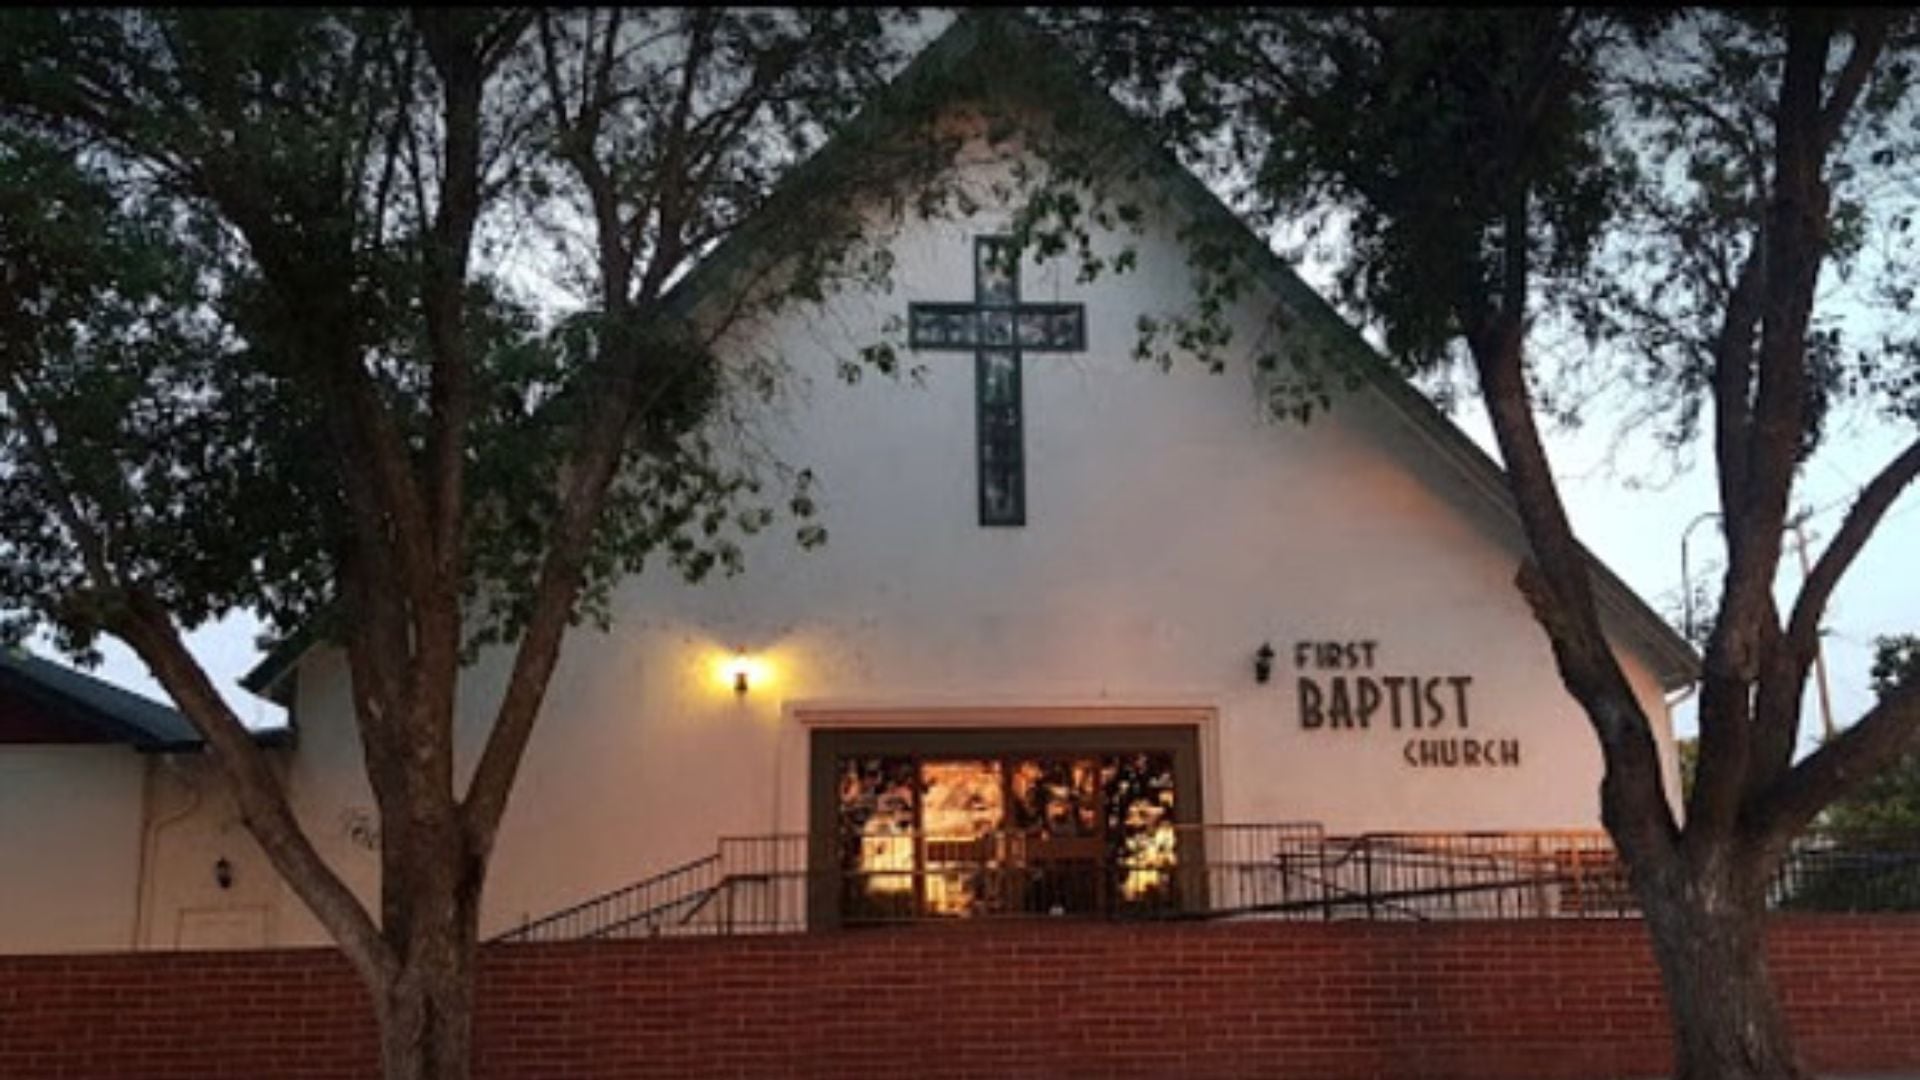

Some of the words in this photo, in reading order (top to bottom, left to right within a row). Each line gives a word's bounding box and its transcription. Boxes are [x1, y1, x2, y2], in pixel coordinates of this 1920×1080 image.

[1295, 641, 1378, 669] FIRST
[1298, 676, 1473, 730] BAPTIST
[1403, 739, 1520, 767] CHURCH
